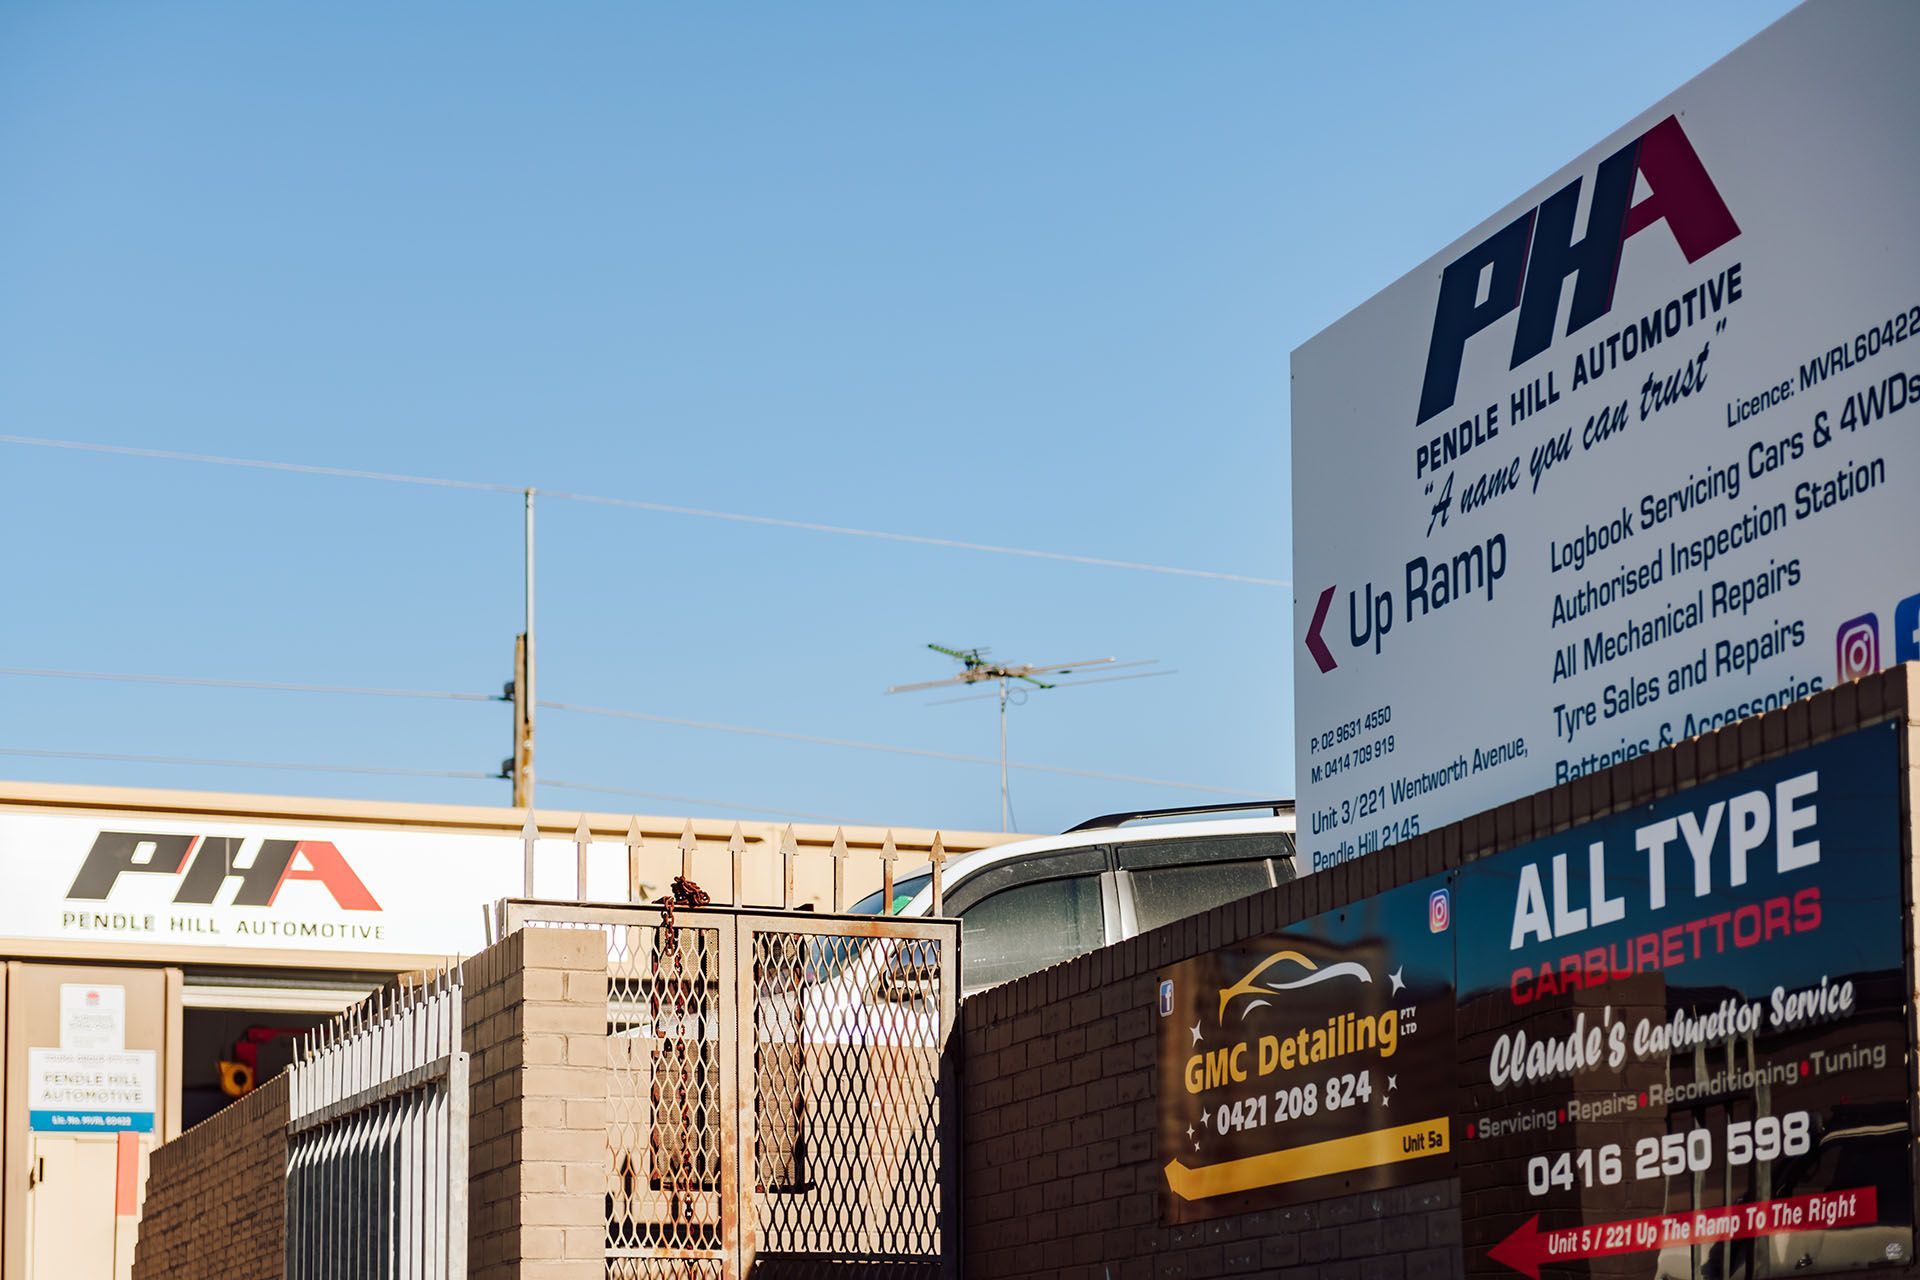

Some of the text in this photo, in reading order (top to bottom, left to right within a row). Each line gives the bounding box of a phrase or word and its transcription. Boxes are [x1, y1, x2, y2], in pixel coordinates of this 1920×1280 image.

[1416, 114, 1741, 426] PHA
[1417, 263, 1742, 479] PENDLE HILL AUTOMOTIVE
[1727, 306, 1920, 428] Licence: MVRL60422
[1461, 457, 1520, 514] name
[1530, 428, 1572, 494] you
[1583, 400, 1628, 450] can
[1551, 372, 1920, 573] Logbook Servicing Cars & 4WDs
[1552, 457, 1885, 629] Authorised Inspection Station
[1350, 533, 1506, 655] Up Ramp
[1553, 558, 1801, 684] All Mechanical Repairs
[1553, 619, 1805, 743] Tyre Sales and Repairs
[1311, 705, 1391, 754] P: 02 9631 4550
[1311, 734, 1395, 784] M: 0414 709 919
[1658, 722, 1673, 748] &
[1312, 737, 1528, 835] Unit 3/221 Wentworth Avenue,
[65, 831, 383, 911] PHA
[1313, 814, 1420, 873] Pendle Hill 2145
[1509, 770, 1821, 950] ALL TYPE
[63, 912, 385, 940] PENDLE HILL AUTOMOTIVE
[1510, 886, 1823, 1005] CARBURETTORS
[1184, 1009, 1397, 1095] GMC Detailing
[1400, 1006, 1417, 1020] PTY
[1400, 1022, 1418, 1036] LTD
[1489, 975, 1853, 1088] Claude's Carburettor Service
[43, 1073, 143, 1103] PENDLE HILL AUTOMOTIVE
[1217, 1070, 1372, 1136] 0421 208 824
[1479, 1044, 1886, 1139] Servicing Repairs Reconditioning Tuning
[1402, 1130, 1443, 1154] Unit 5a
[1527, 1110, 1810, 1197] 0416 250 598
[1549, 1194, 1856, 1255] Unit 5 / 221 Up The Ramp To The Right
